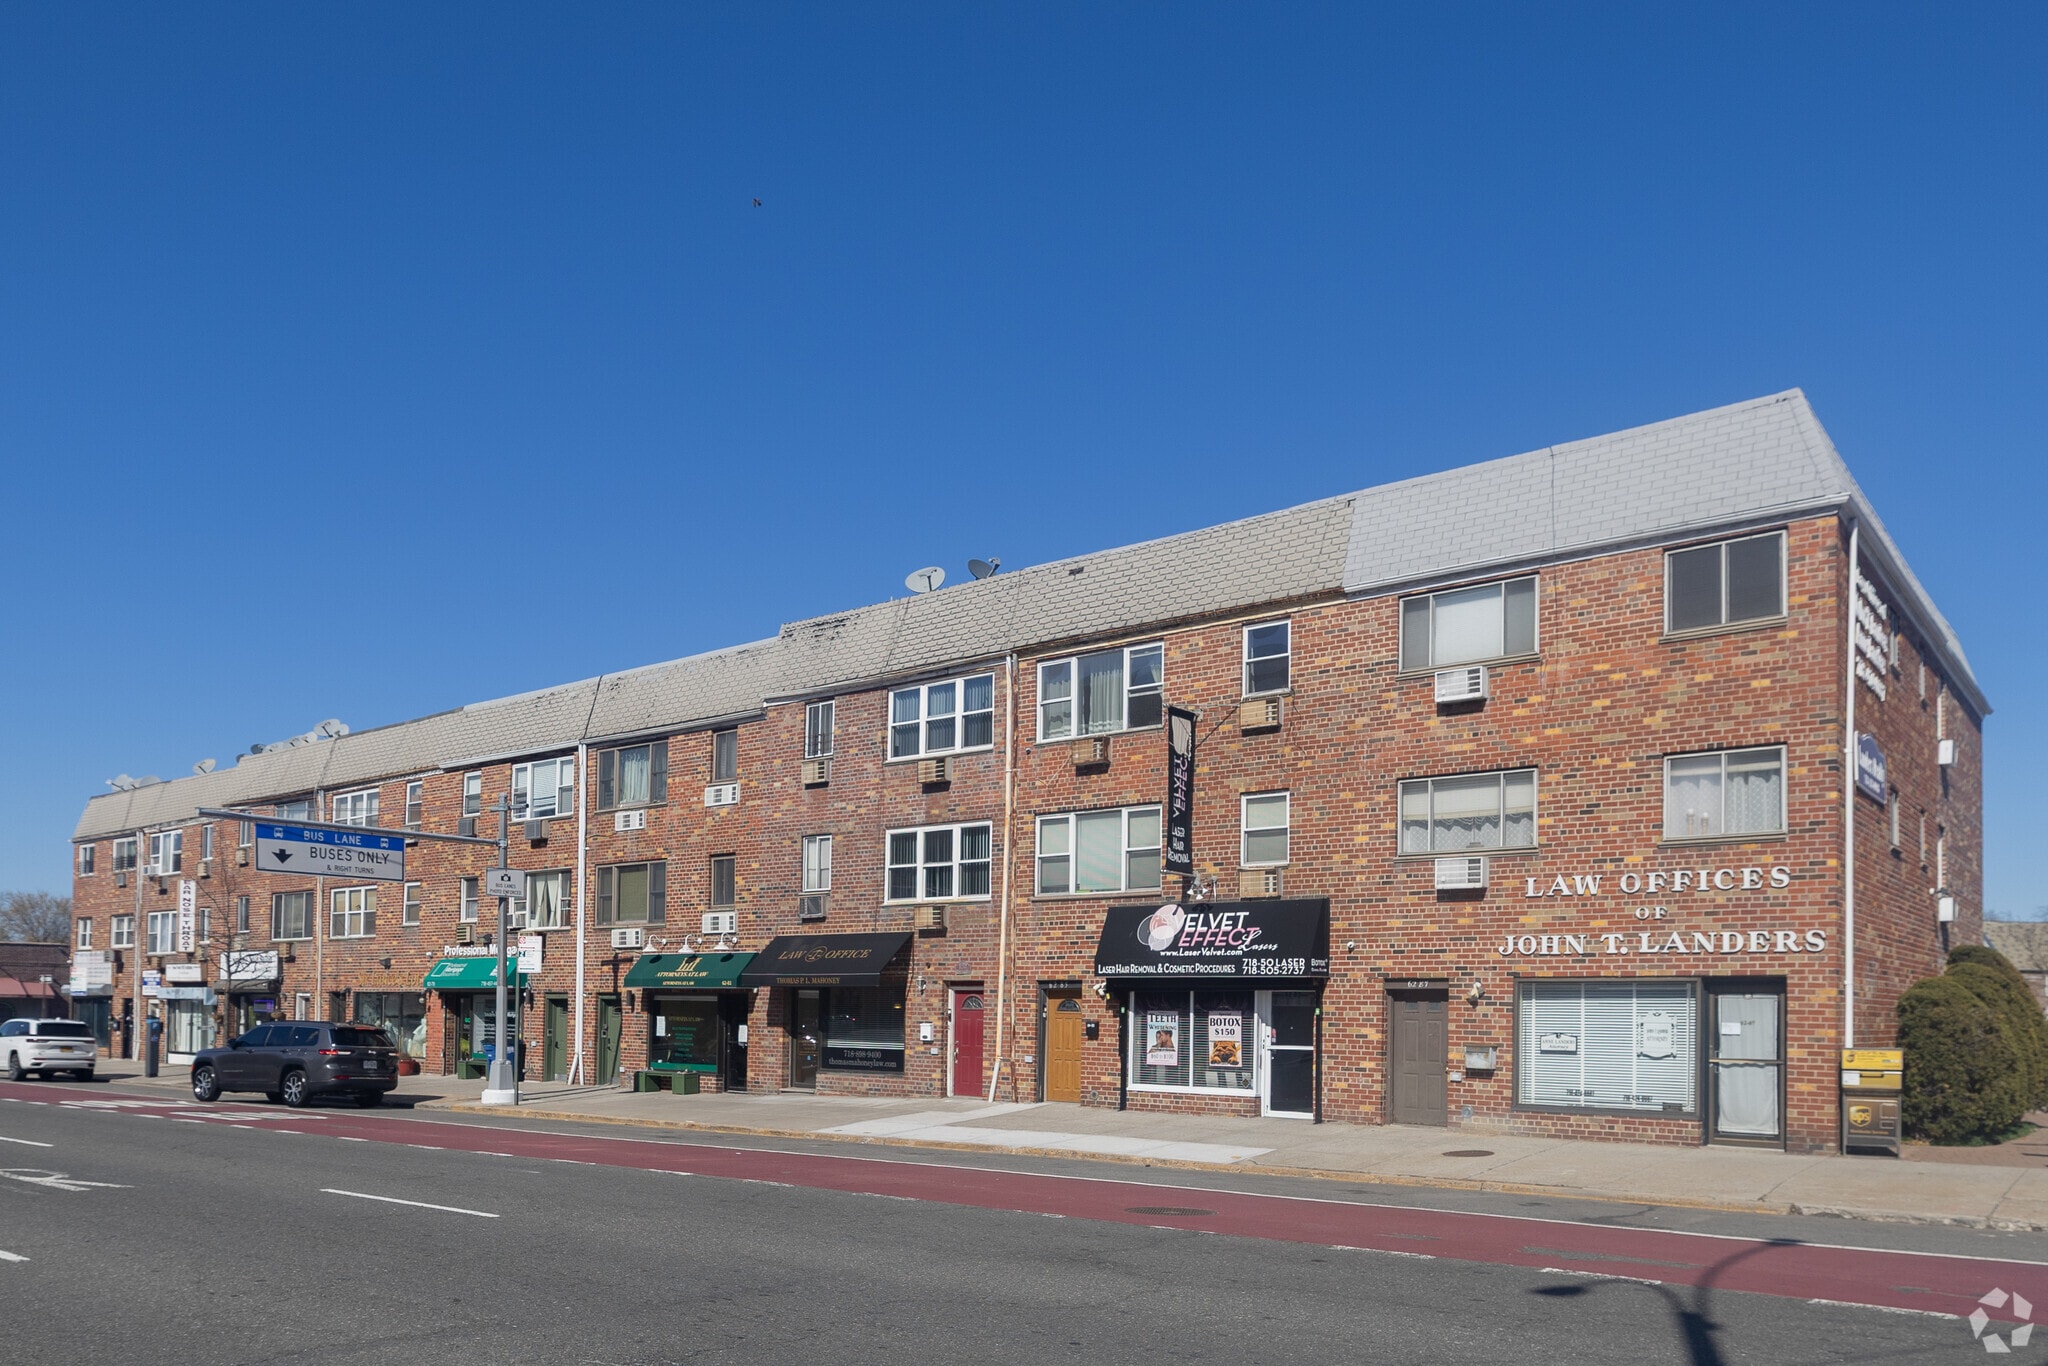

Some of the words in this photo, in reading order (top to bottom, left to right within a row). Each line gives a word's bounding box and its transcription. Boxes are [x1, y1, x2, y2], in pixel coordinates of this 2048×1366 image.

[303, 830, 324, 842] BUS
[334, 833, 362, 846] LANE
[309, 846, 353, 862] BUSES
[357, 851, 389, 865] ONLY
[334, 865, 352, 873] RIGHT
[354, 867, 374, 875] TURNS
[183, 880, 191, 894] EAR
[1525, 874, 1603, 898] LAW
[1619, 866, 1792, 896] OFFICES
[182, 898, 191, 918] NOSE
[1634, 906, 1668, 921] OF
[181, 921, 191, 951] THROAT
[1178, 927, 1261, 947] EFFECT
[1238, 930, 1279, 951] Lasers
[1498, 933, 1587, 957] JOHN
[1600, 933, 1629, 955] T.
[1638, 929, 1827, 955] LANDERS
[444, 945, 488, 956] Professional
[778, 951, 806, 960] LAW
[825, 949, 872, 959] OFFICE
[1157, 963, 1163, 973] &
[1242, 958, 1274, 967] 718-50
[1275, 958, 1305, 967] LASER
[1242, 966, 1306, 975] 718-505-2737
[1149, 1013, 1177, 1023] TEETH
[1209, 1018, 1241, 1027] BOTOX
[1214, 1028, 1235, 1036] $150
